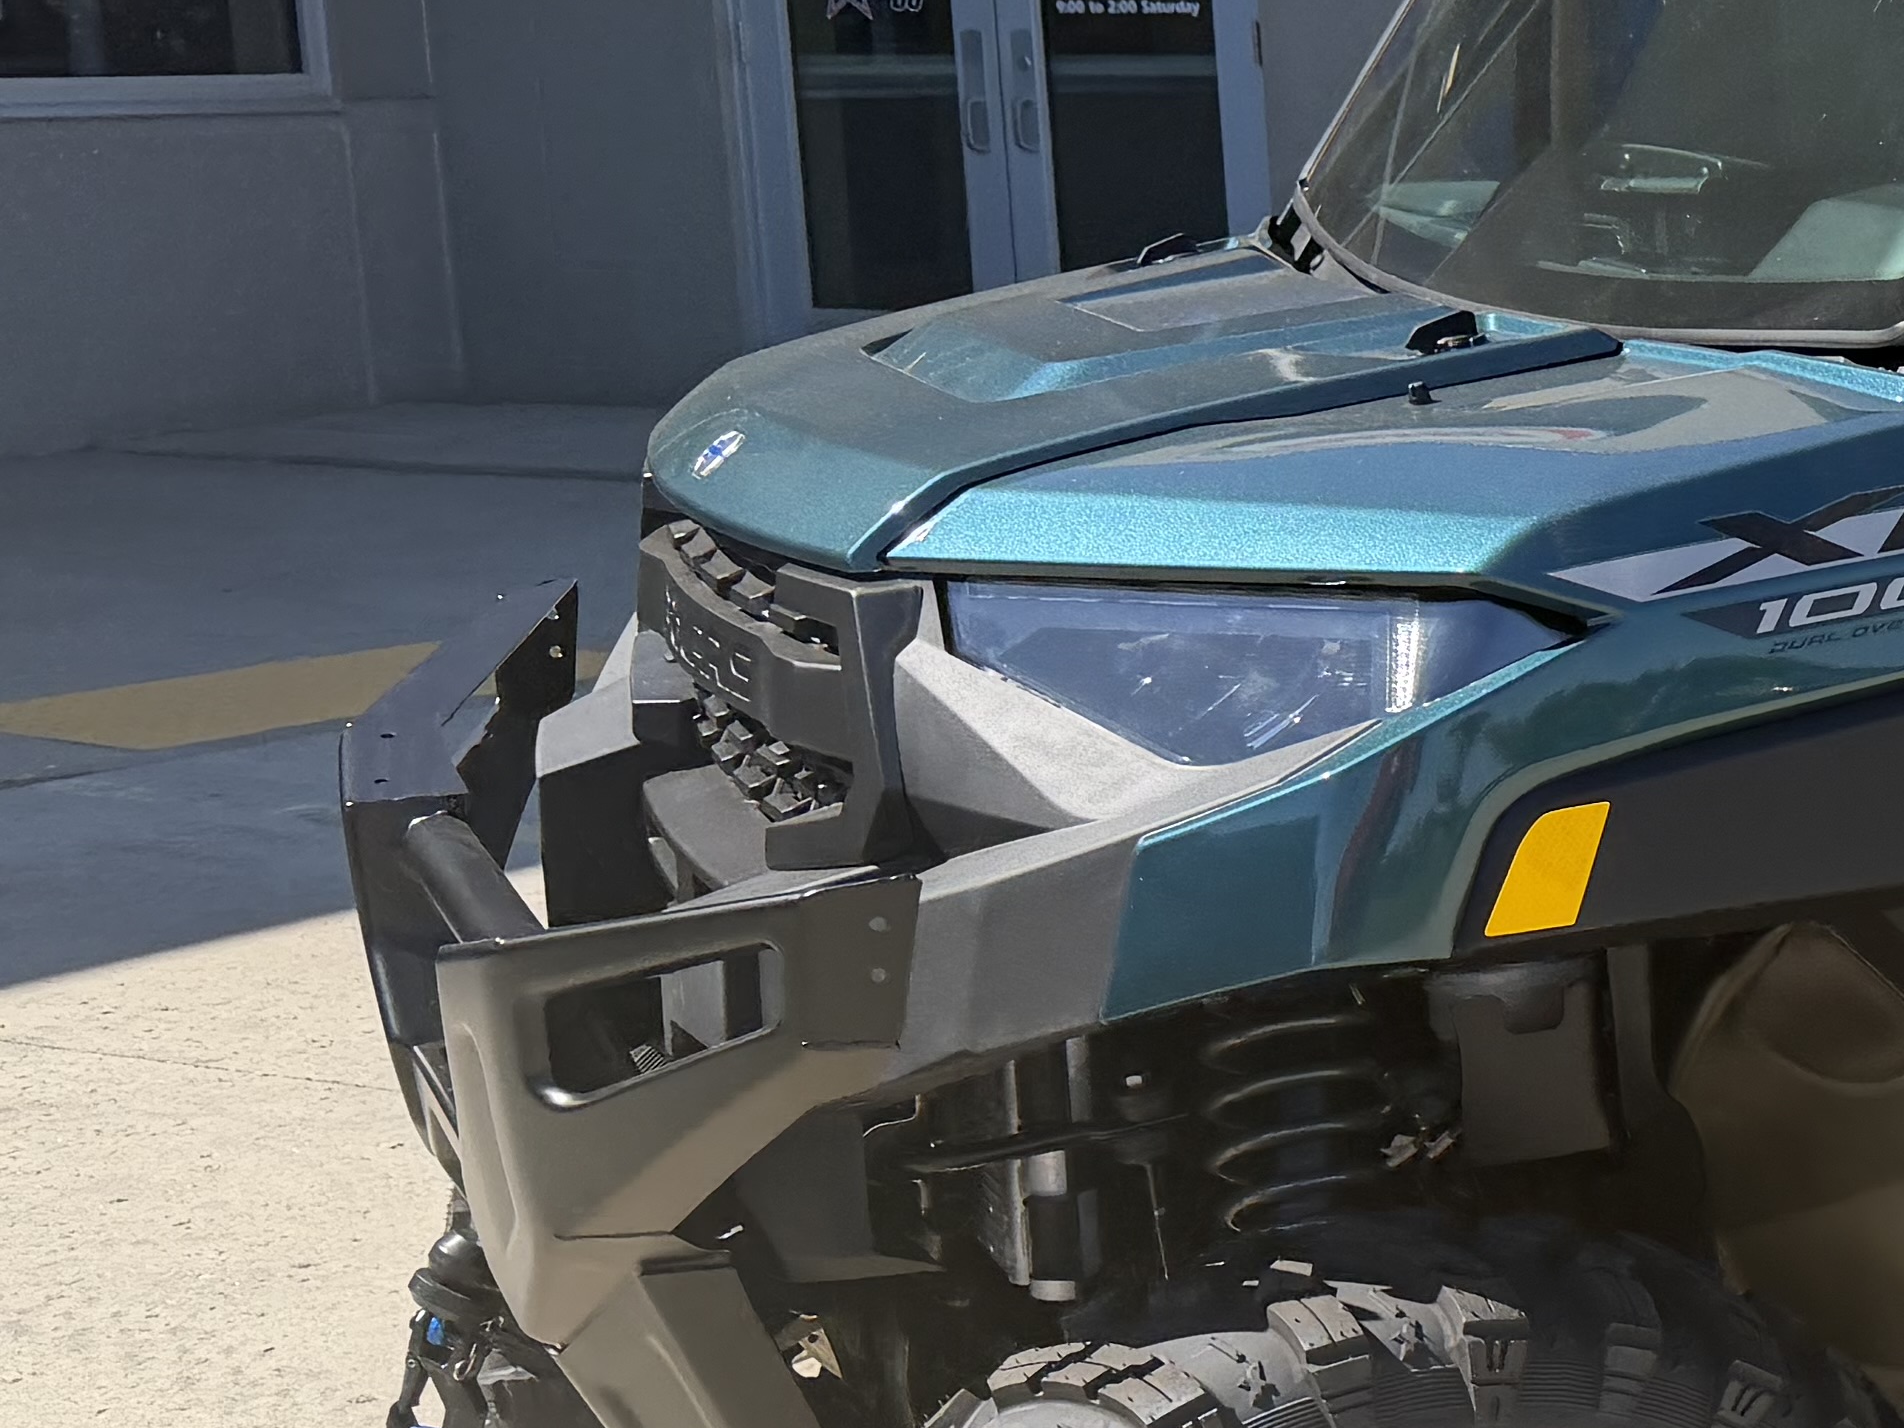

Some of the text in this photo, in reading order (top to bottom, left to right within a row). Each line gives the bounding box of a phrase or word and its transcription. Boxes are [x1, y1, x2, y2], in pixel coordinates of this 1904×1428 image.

[1088, 0, 1105, 14] to
[1107, 0, 1138, 15] 2:00
[1140, 0, 1201, 18] Saturday
[1769, 631, 1842, 654] DUAL
